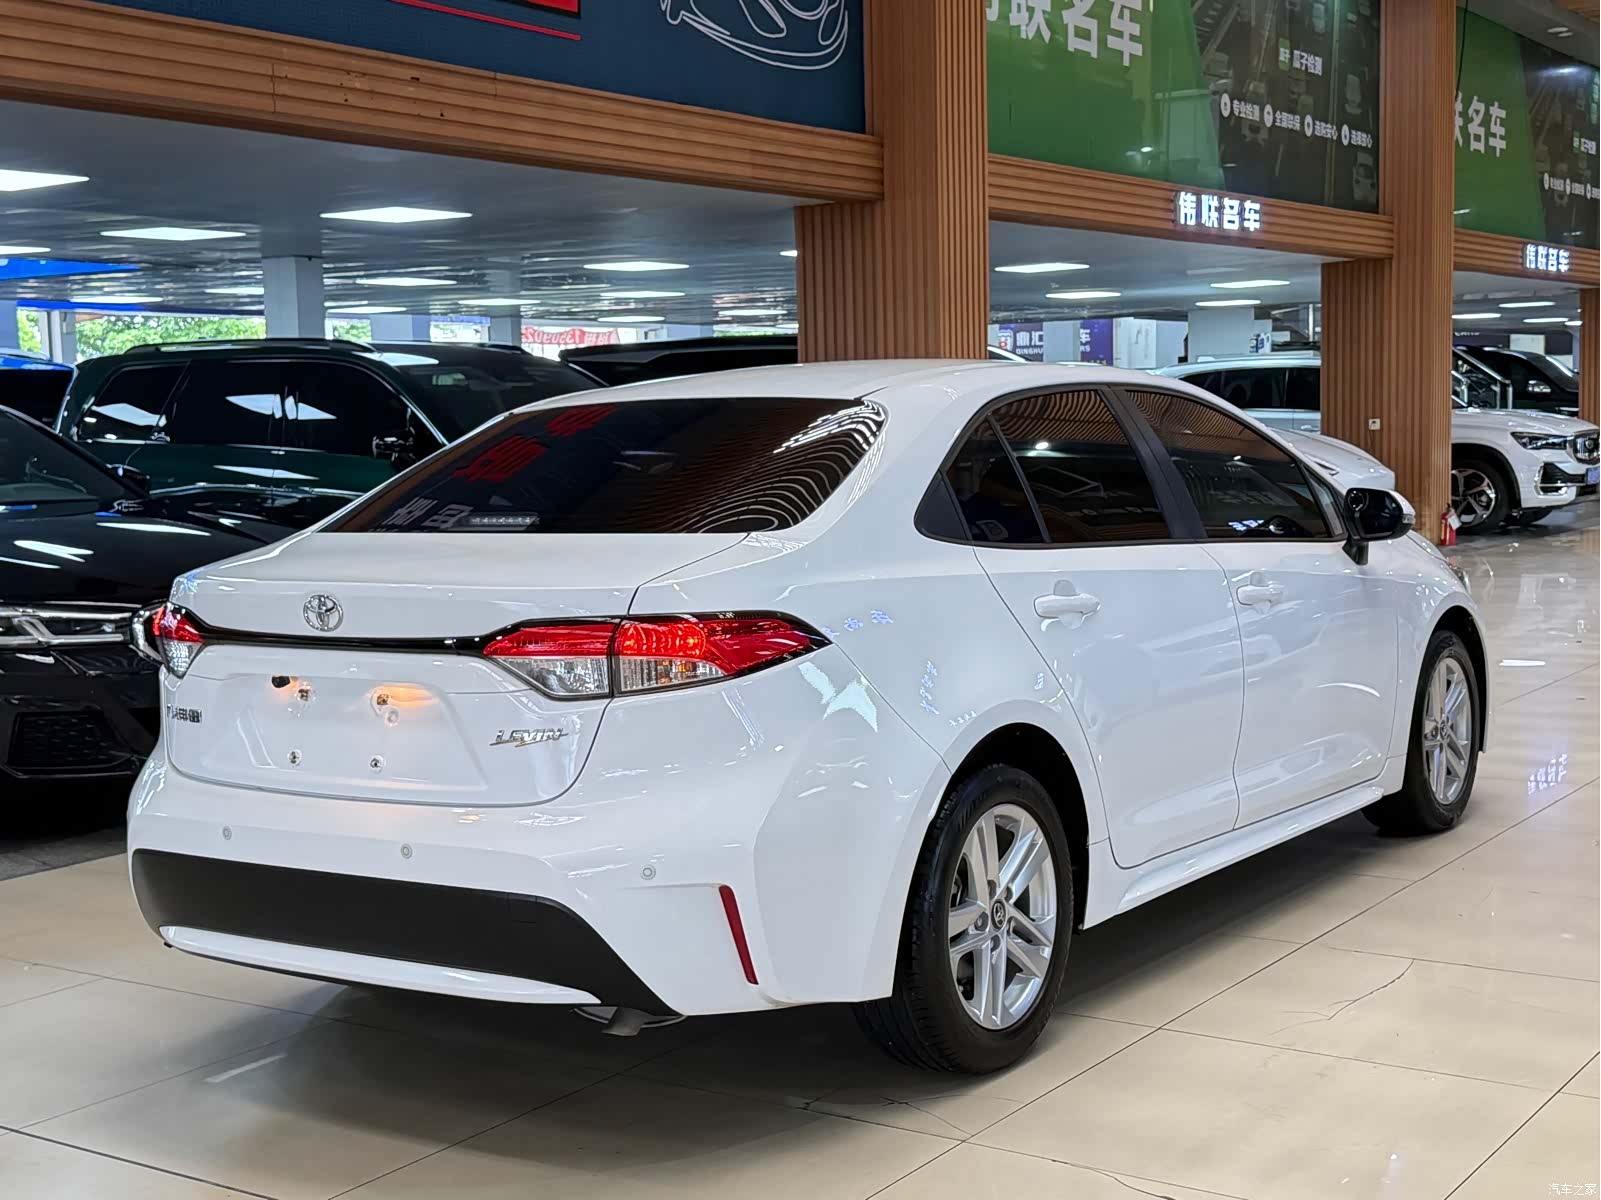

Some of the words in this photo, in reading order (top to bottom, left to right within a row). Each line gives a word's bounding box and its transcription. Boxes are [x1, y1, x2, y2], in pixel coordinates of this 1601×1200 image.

[986, 0, 1143, 66] 联名车
[1179, 191, 1261, 231] 伟联名车
[491, 728, 566, 747] LEVIN
